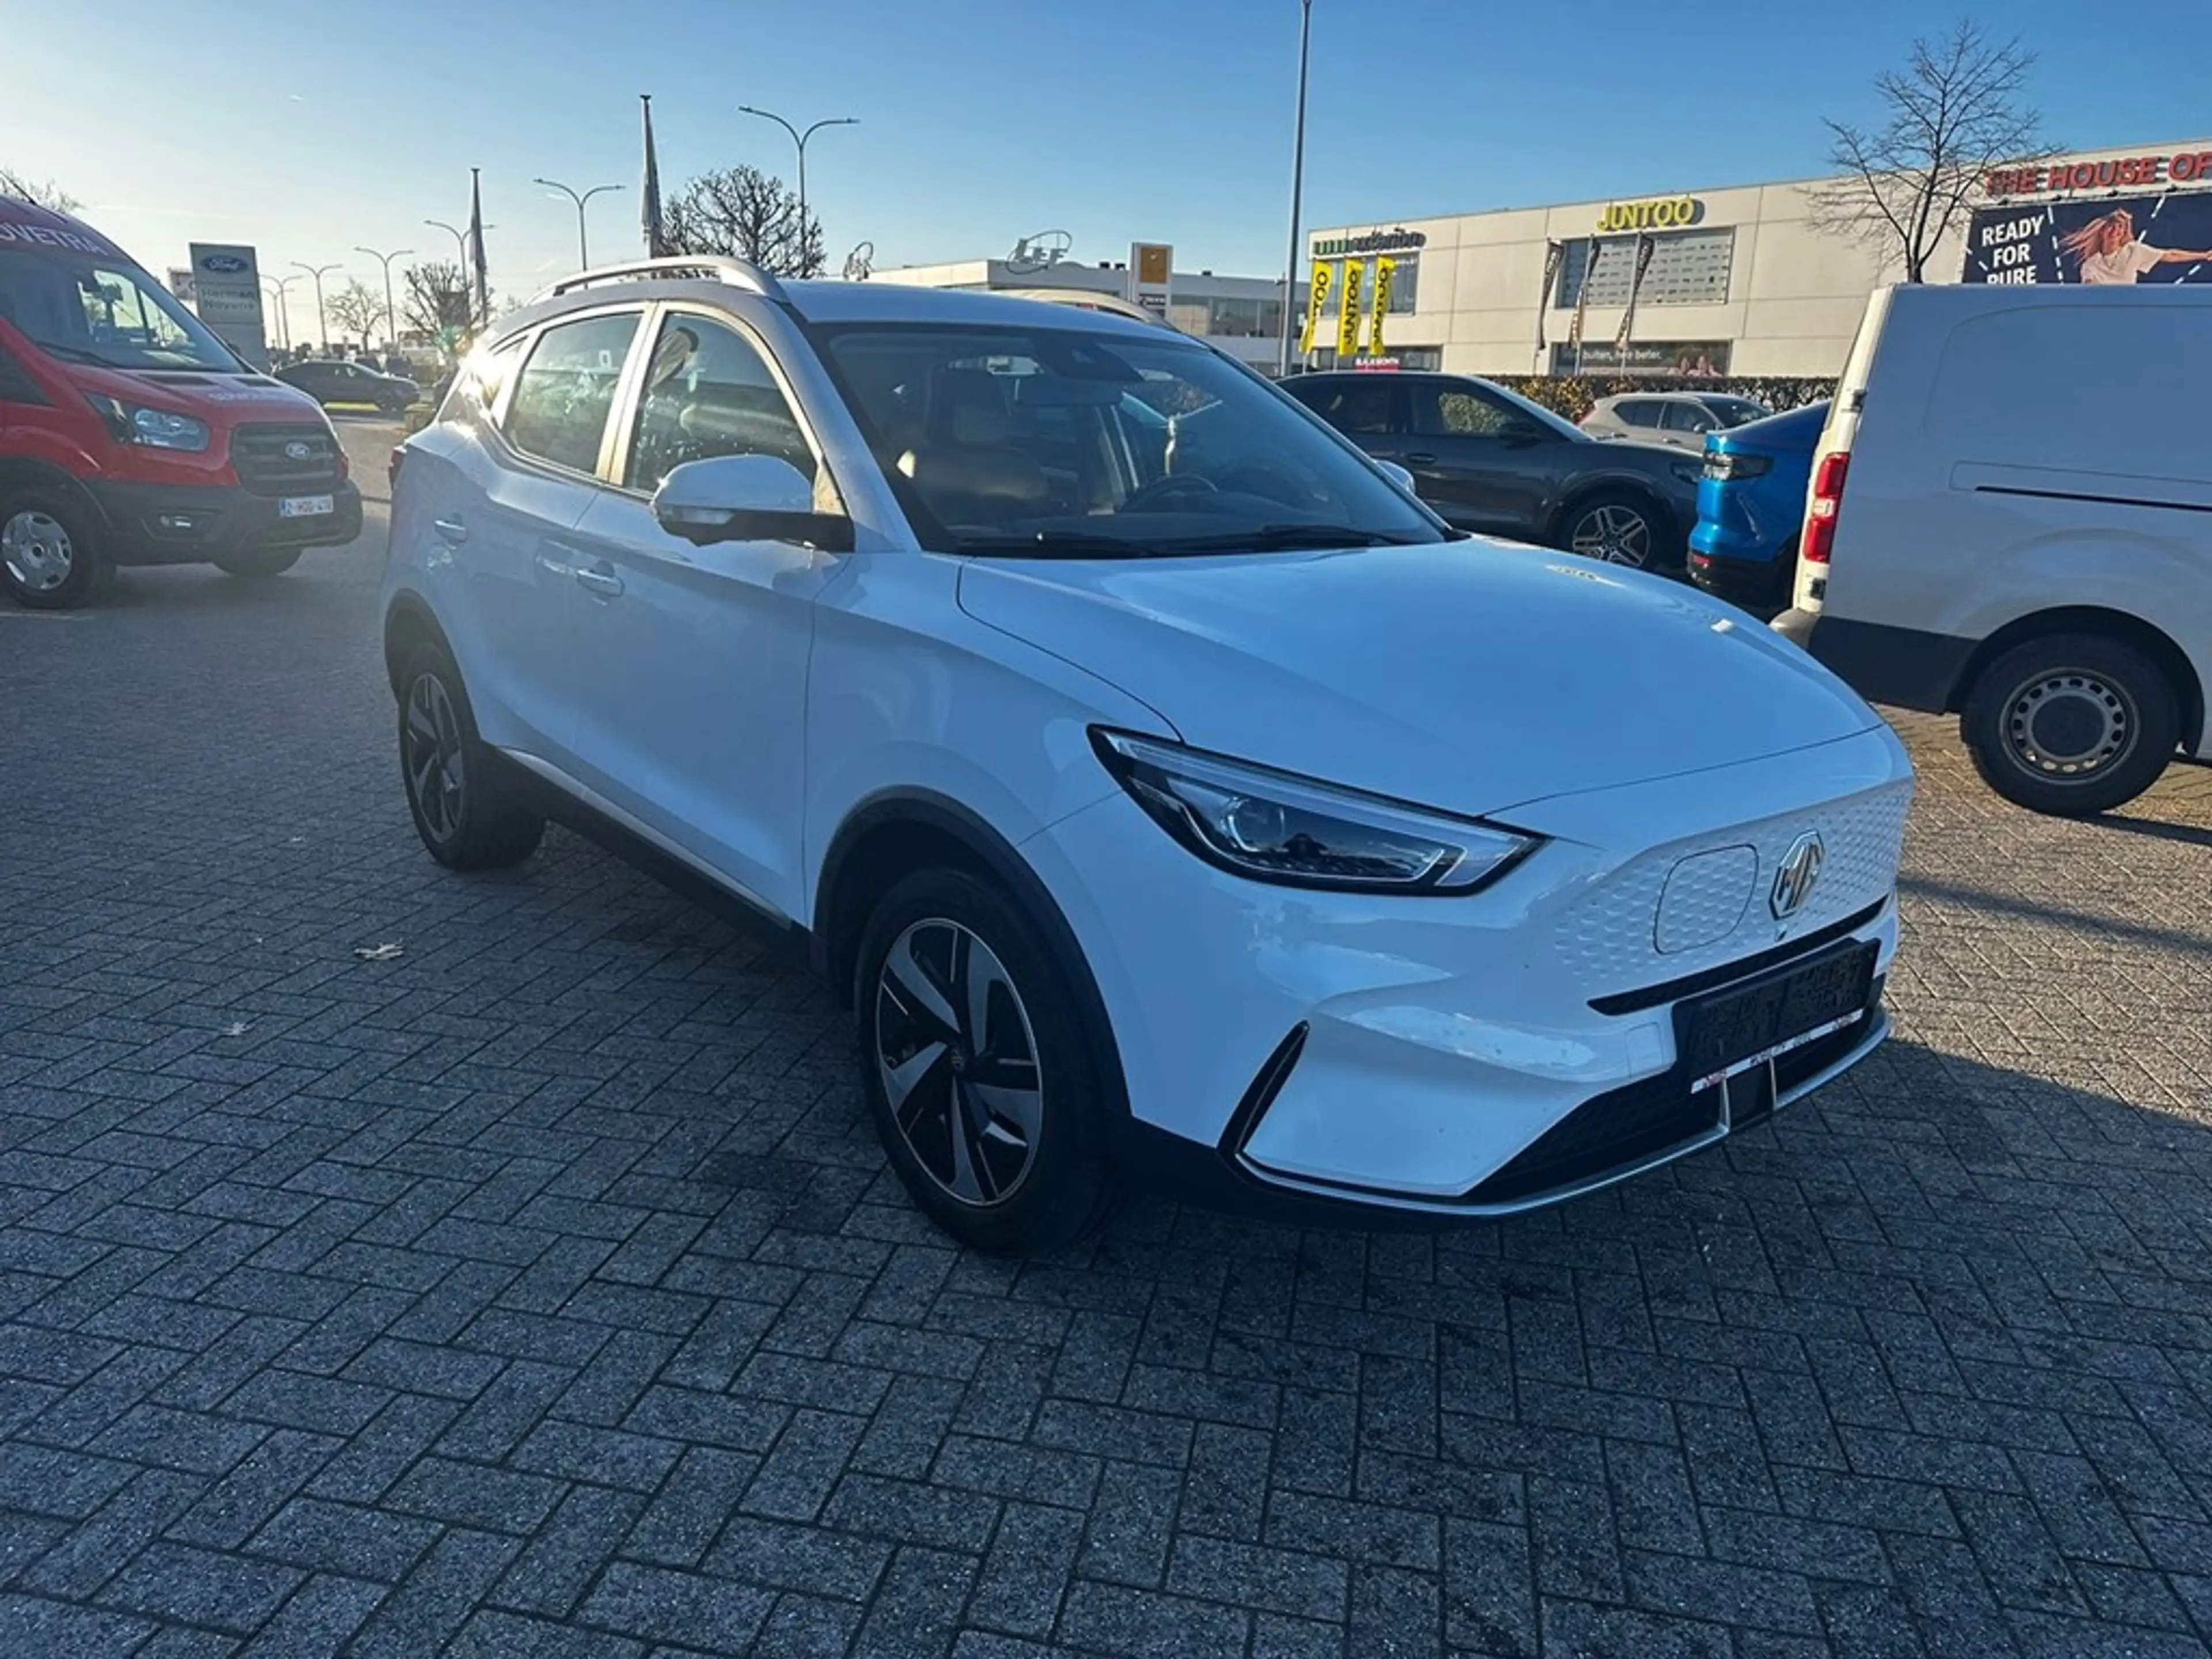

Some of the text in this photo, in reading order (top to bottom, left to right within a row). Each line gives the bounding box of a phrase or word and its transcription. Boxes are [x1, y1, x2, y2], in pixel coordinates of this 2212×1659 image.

[1984, 166, 2037, 195] THE
[2047, 157, 2158, 190] HOUSE
[1596, 198, 1695, 231] JUNTOO
[1982, 213, 2045, 247] READY
[1993, 242, 2031, 269] FOR
[1987, 264, 2038, 284] PURE
[1343, 270, 1358, 345] JUNTOO
